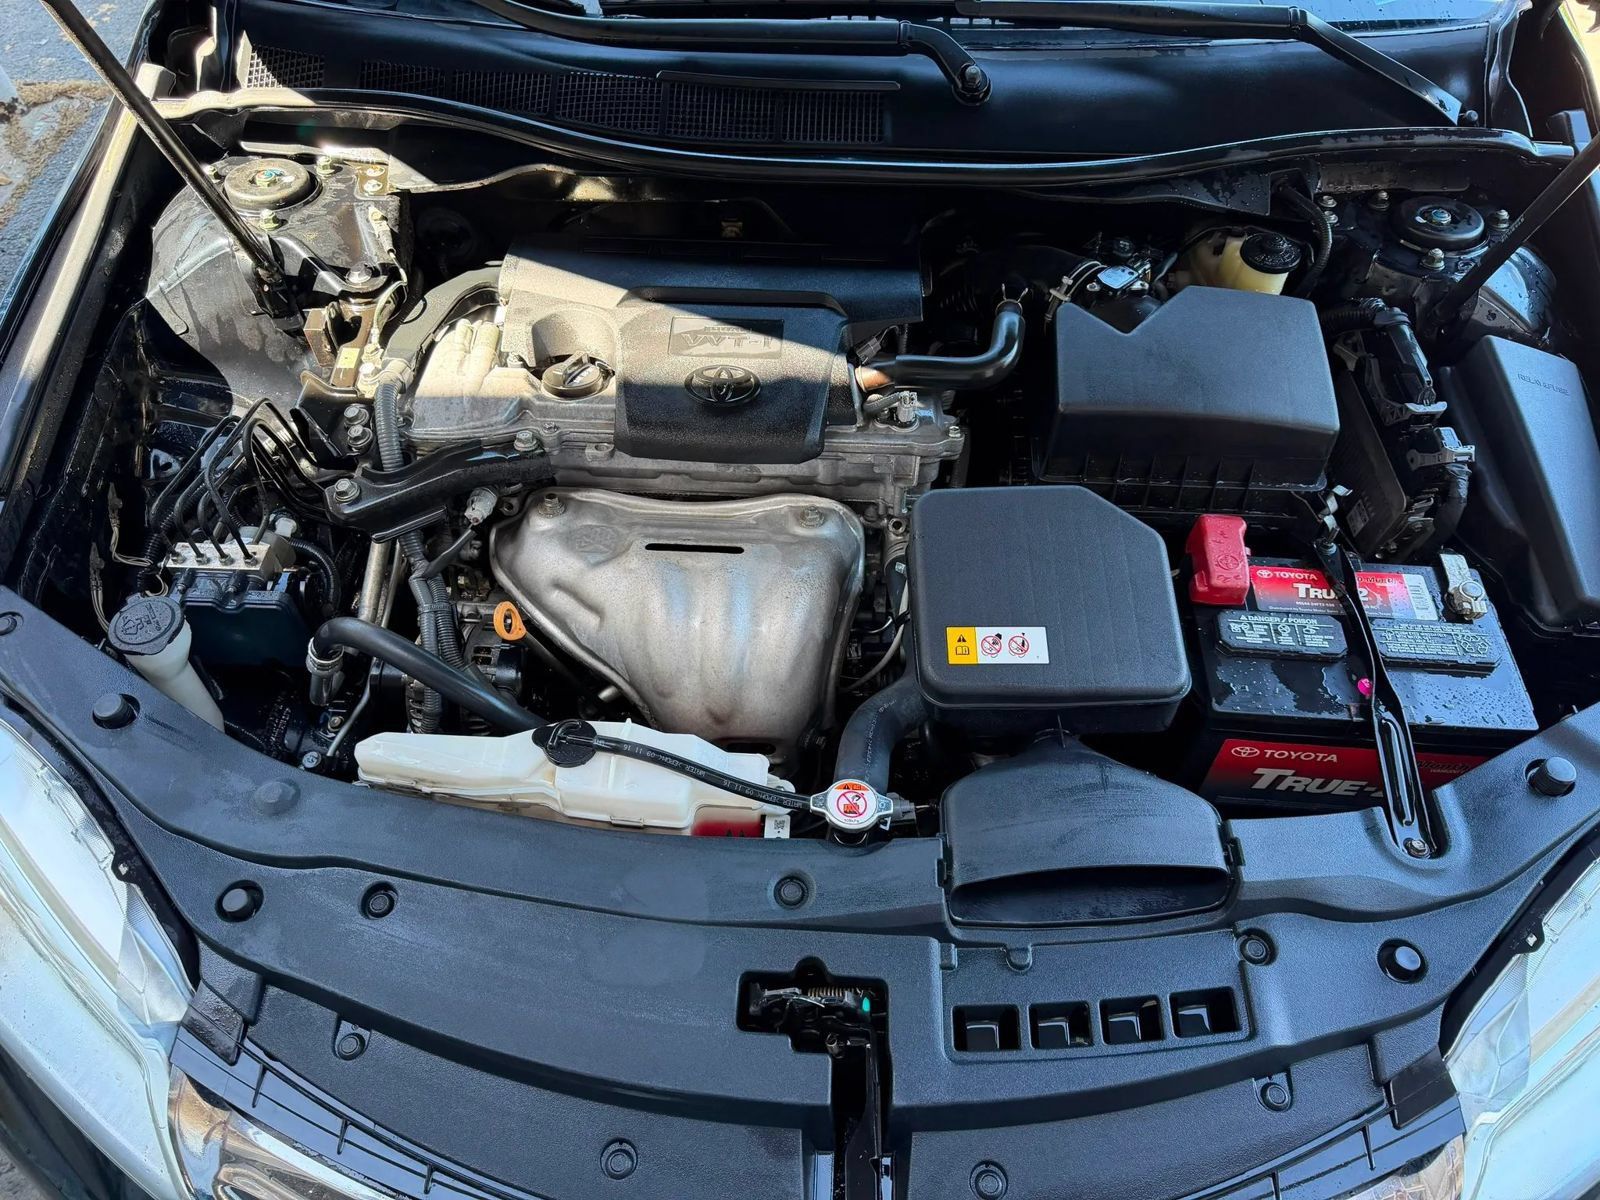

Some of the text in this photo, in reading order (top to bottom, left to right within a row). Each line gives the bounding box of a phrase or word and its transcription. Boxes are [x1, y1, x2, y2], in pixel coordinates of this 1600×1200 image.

[1273, 571, 1318, 581] TOYOTA
[1248, 615, 1281, 623] DANGER
[1288, 617, 1318, 625] POISON
[1263, 749, 1338, 763] TOYOTA
